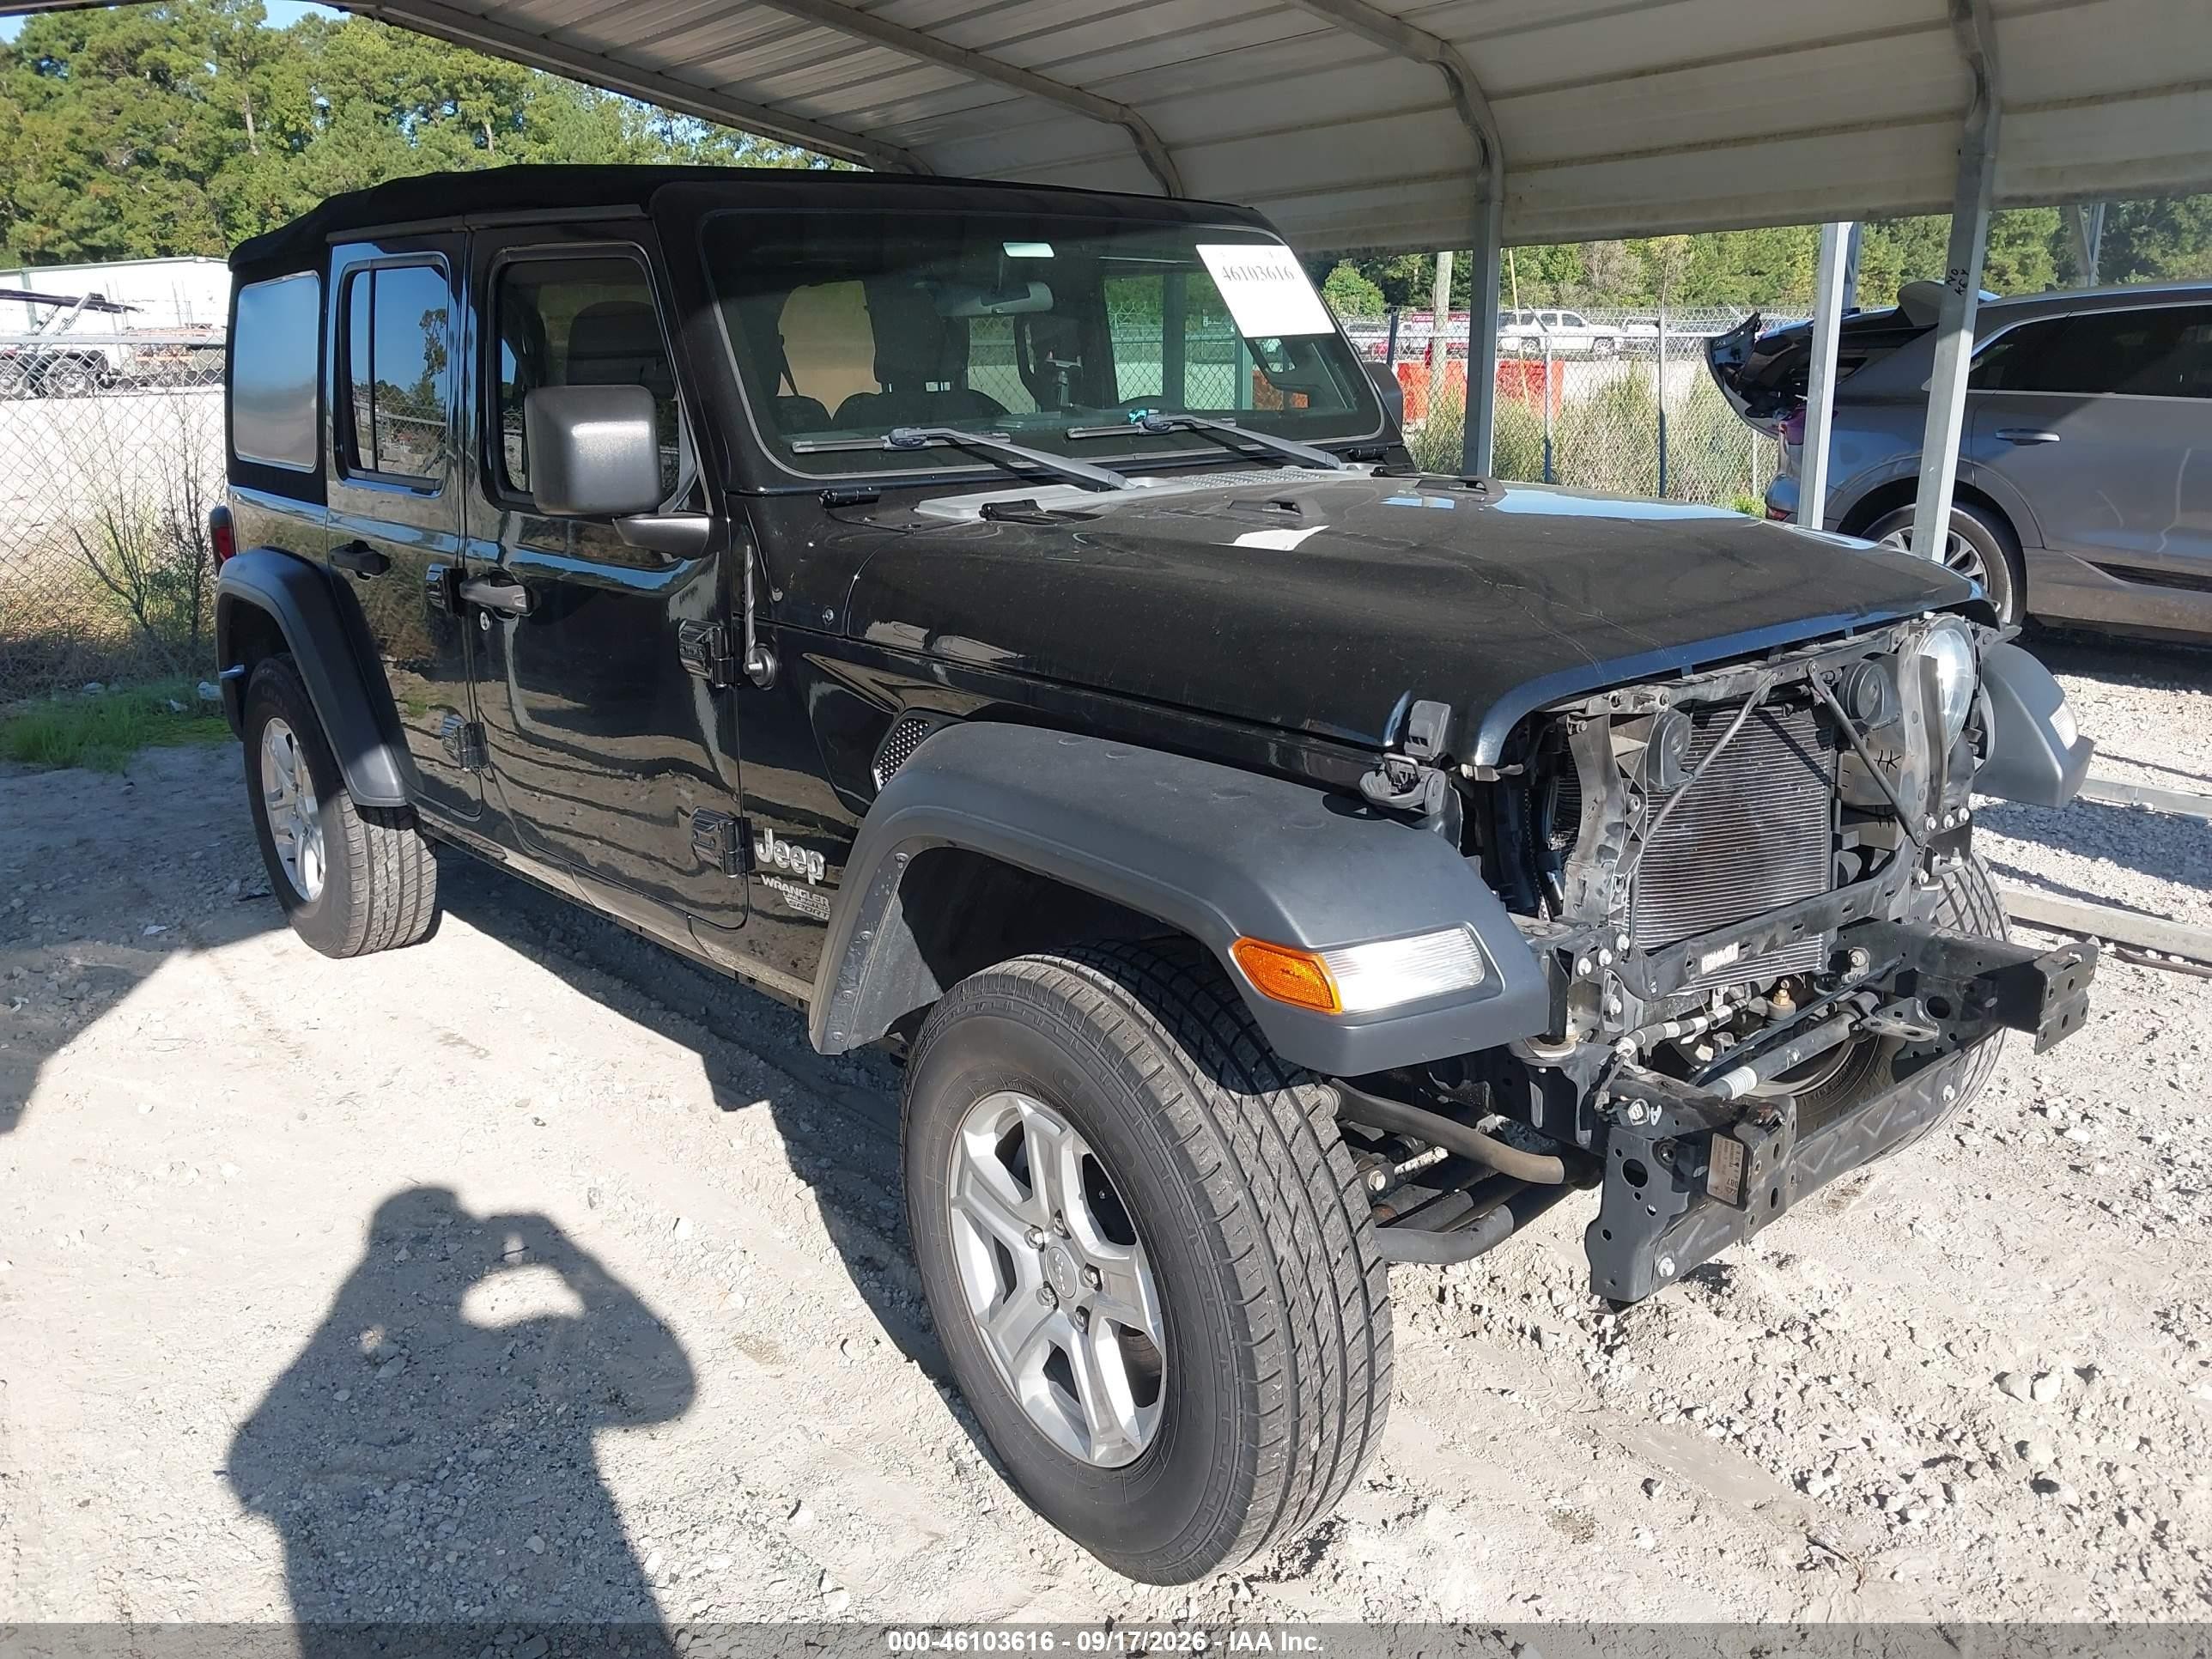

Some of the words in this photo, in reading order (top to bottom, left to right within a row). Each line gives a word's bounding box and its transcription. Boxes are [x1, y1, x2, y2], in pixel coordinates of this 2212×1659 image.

[1223, 264, 1295, 282] 46103616
[1946, 268, 1960, 286] NO
[1954, 269, 1970, 297] KEY
[755, 827, 826, 885] Jeep
[760, 873, 830, 907] WRANGLER
[782, 890, 831, 912] UNLIMITED
[788, 899, 830, 921] SPORT
